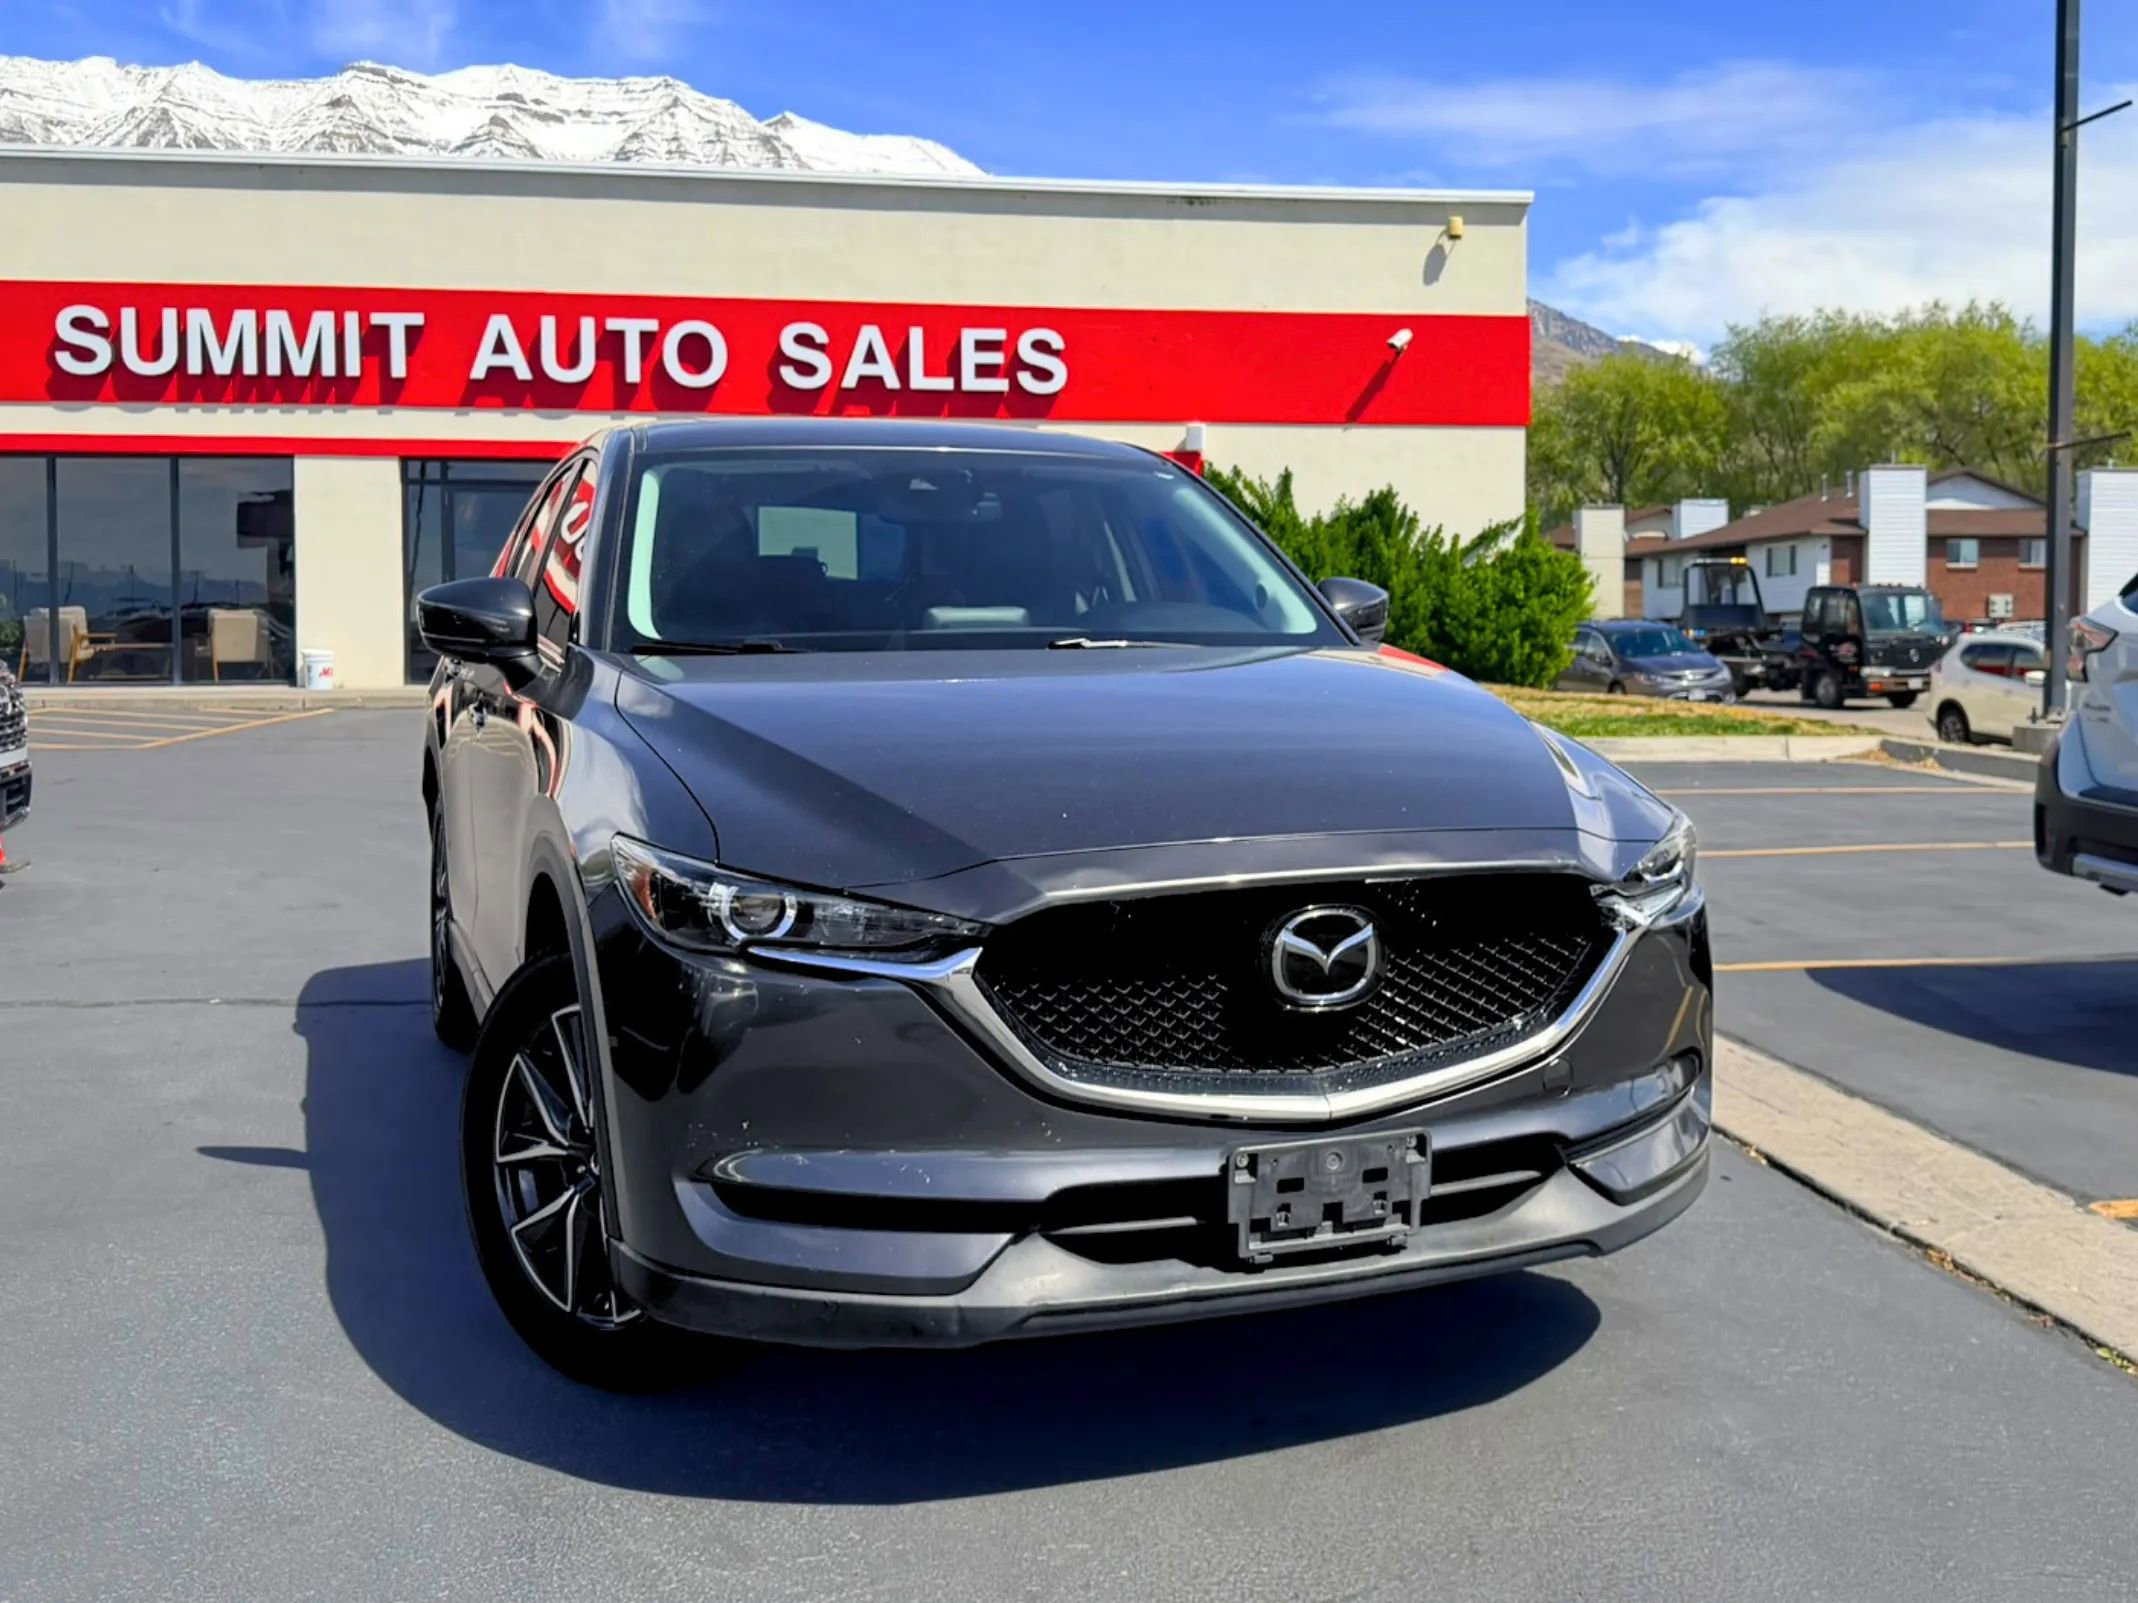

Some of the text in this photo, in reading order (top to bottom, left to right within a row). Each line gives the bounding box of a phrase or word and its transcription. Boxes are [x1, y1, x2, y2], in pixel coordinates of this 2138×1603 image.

[54, 303, 1069, 397] SUMMIT AUTO SALES
